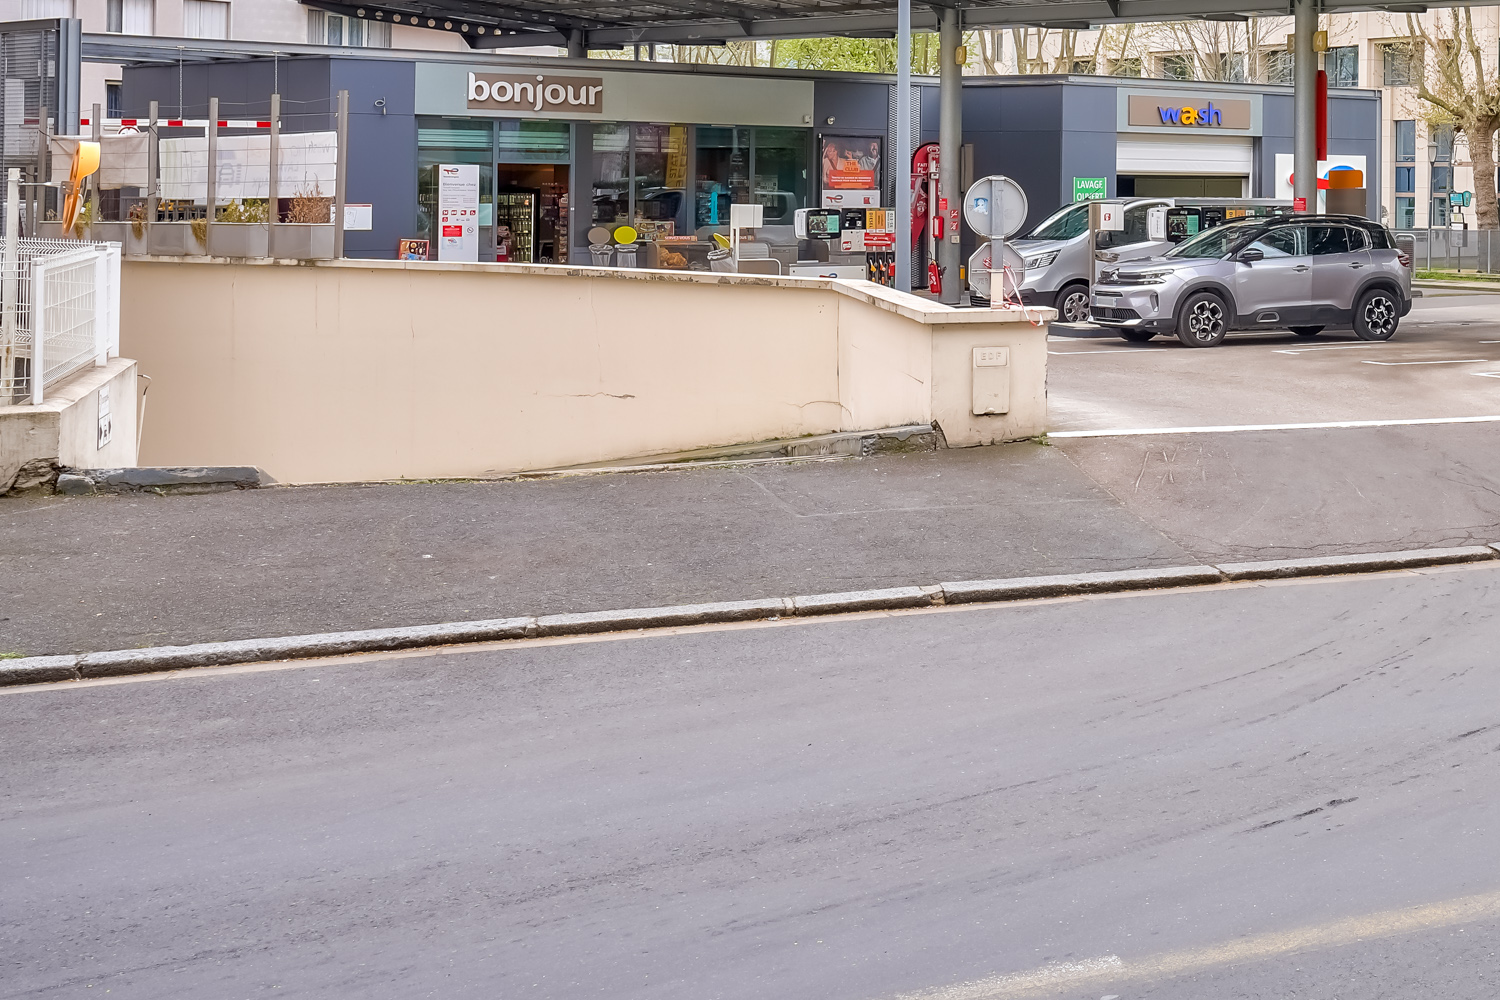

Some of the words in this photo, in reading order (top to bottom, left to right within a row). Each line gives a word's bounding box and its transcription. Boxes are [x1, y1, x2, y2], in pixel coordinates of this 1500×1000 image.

[1316, 34, 1323, 47] 4
[468, 71, 603, 111] bonjour
[1157, 101, 1222, 126] wash
[1077, 180, 1103, 189] LAVAGE
[981, 352, 1002, 361] EDF
